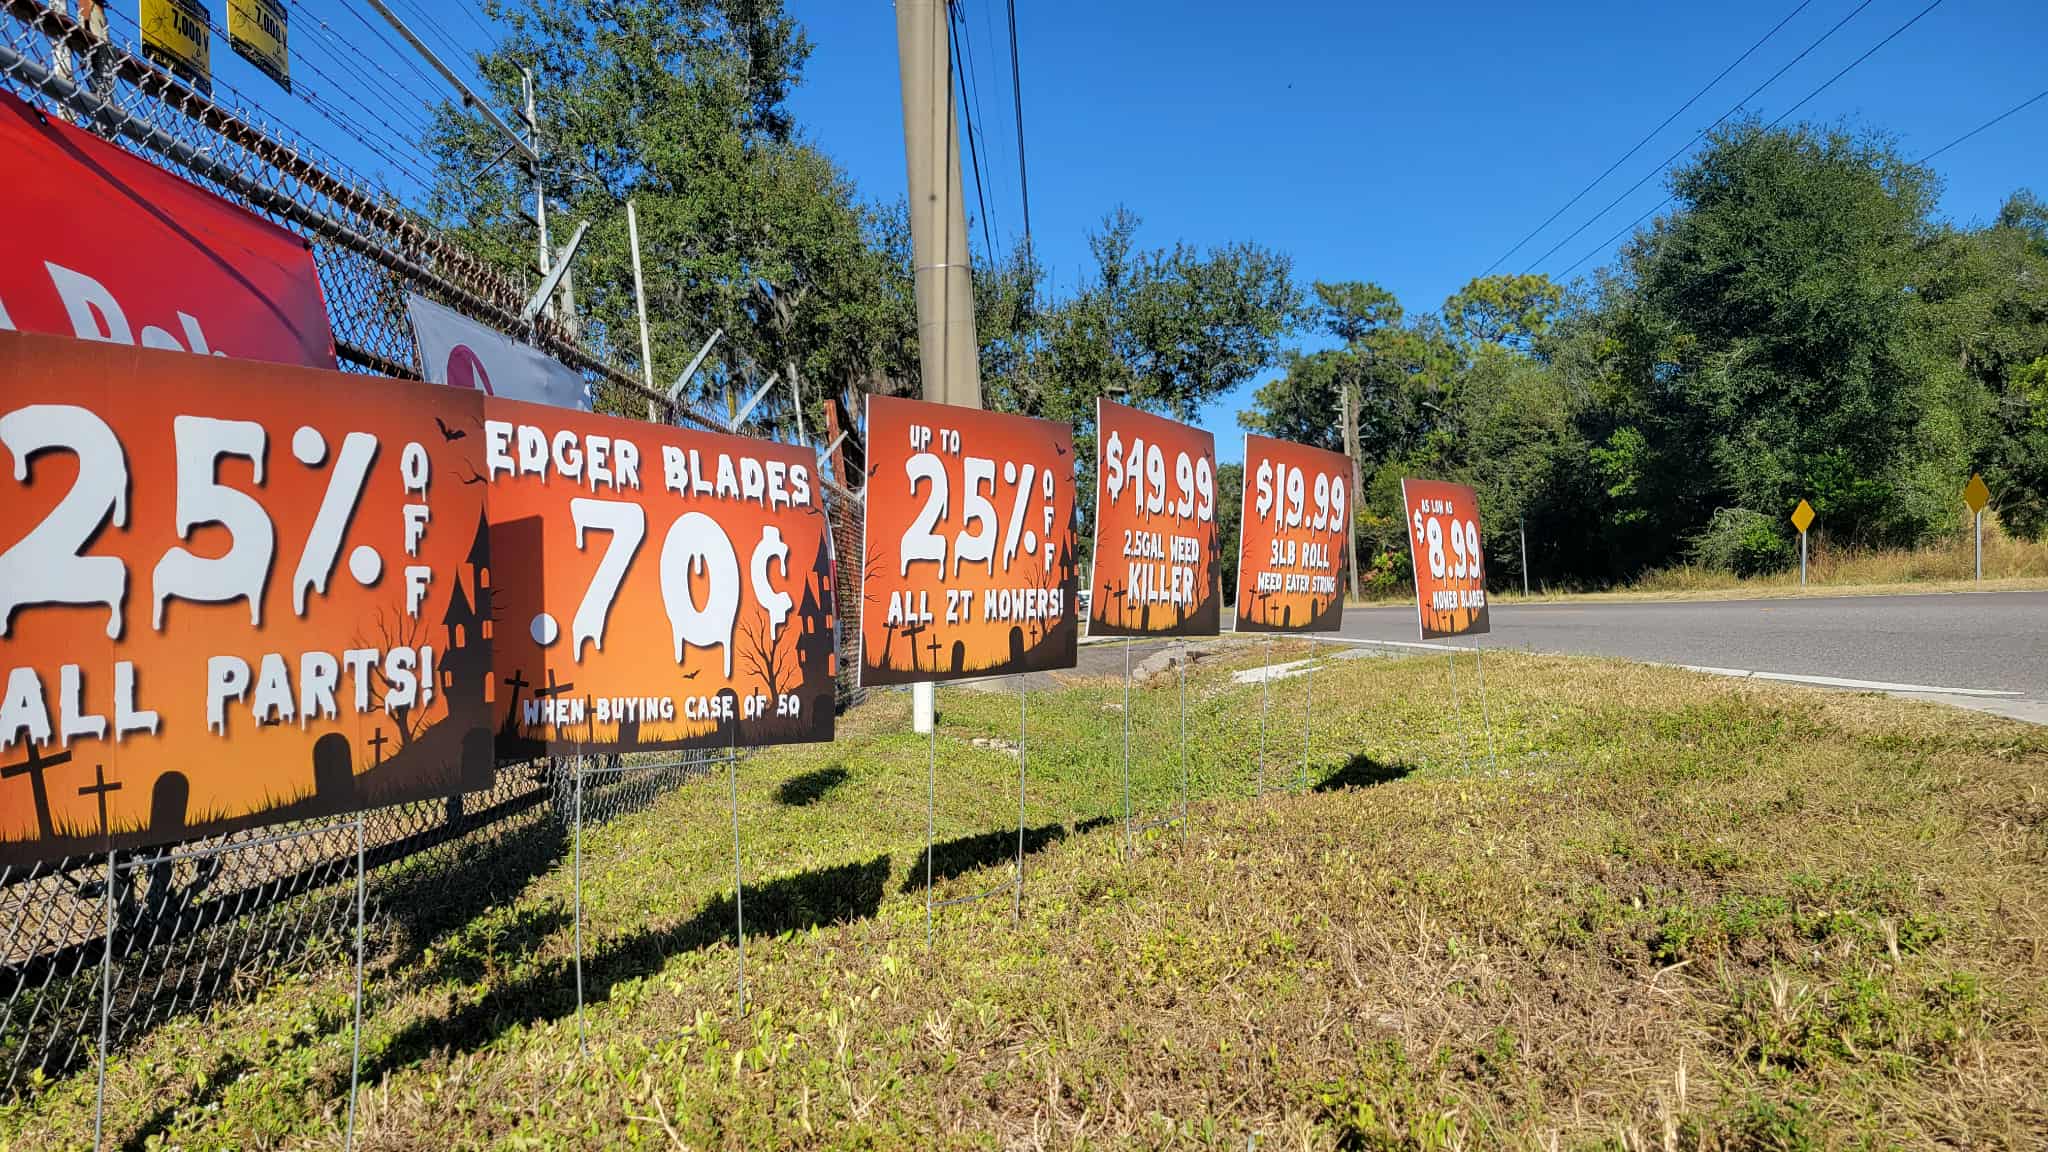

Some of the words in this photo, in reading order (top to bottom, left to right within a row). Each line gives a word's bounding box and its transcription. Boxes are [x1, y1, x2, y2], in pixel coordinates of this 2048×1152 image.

[485, 420, 640, 493] EDGER
[662, 446, 810, 511] BLADES
[910, 424, 932, 453] UP
[940, 429, 960, 455] TO
[901, 452, 1037, 580] 25%
[1106, 430, 1213, 529] $49.99
[1256, 458, 1345, 538] $19.99
[0, 404, 383, 639] 25%
[401, 442, 431, 617] OFF
[1043, 469, 1055, 574] OFF
[1170, 534, 1200, 564] WEED
[1270, 539, 1296, 568] 3LB
[1302, 541, 1330, 569] ROLL
[1413, 508, 1481, 587] $8.99
[888, 590, 933, 625] ALL
[984, 588, 1064, 624] MOWERS!
[1128, 562, 1194, 613] KILLER
[1257, 571, 1282, 594] WEED
[1286, 573, 1310, 593] EATER
[1312, 575, 1336, 594] STRING
[1432, 591, 1458, 610] MOWER
[1460, 590, 1485, 608] BLADES
[0, 661, 159, 751] ALL
[207, 646, 434, 736] PARTS!
[522, 698, 585, 728] WHEN
[596, 695, 674, 725] BUYING
[685, 695, 733, 725] CASE
[743, 695, 766, 720] OF
[777, 694, 801, 719] 50
